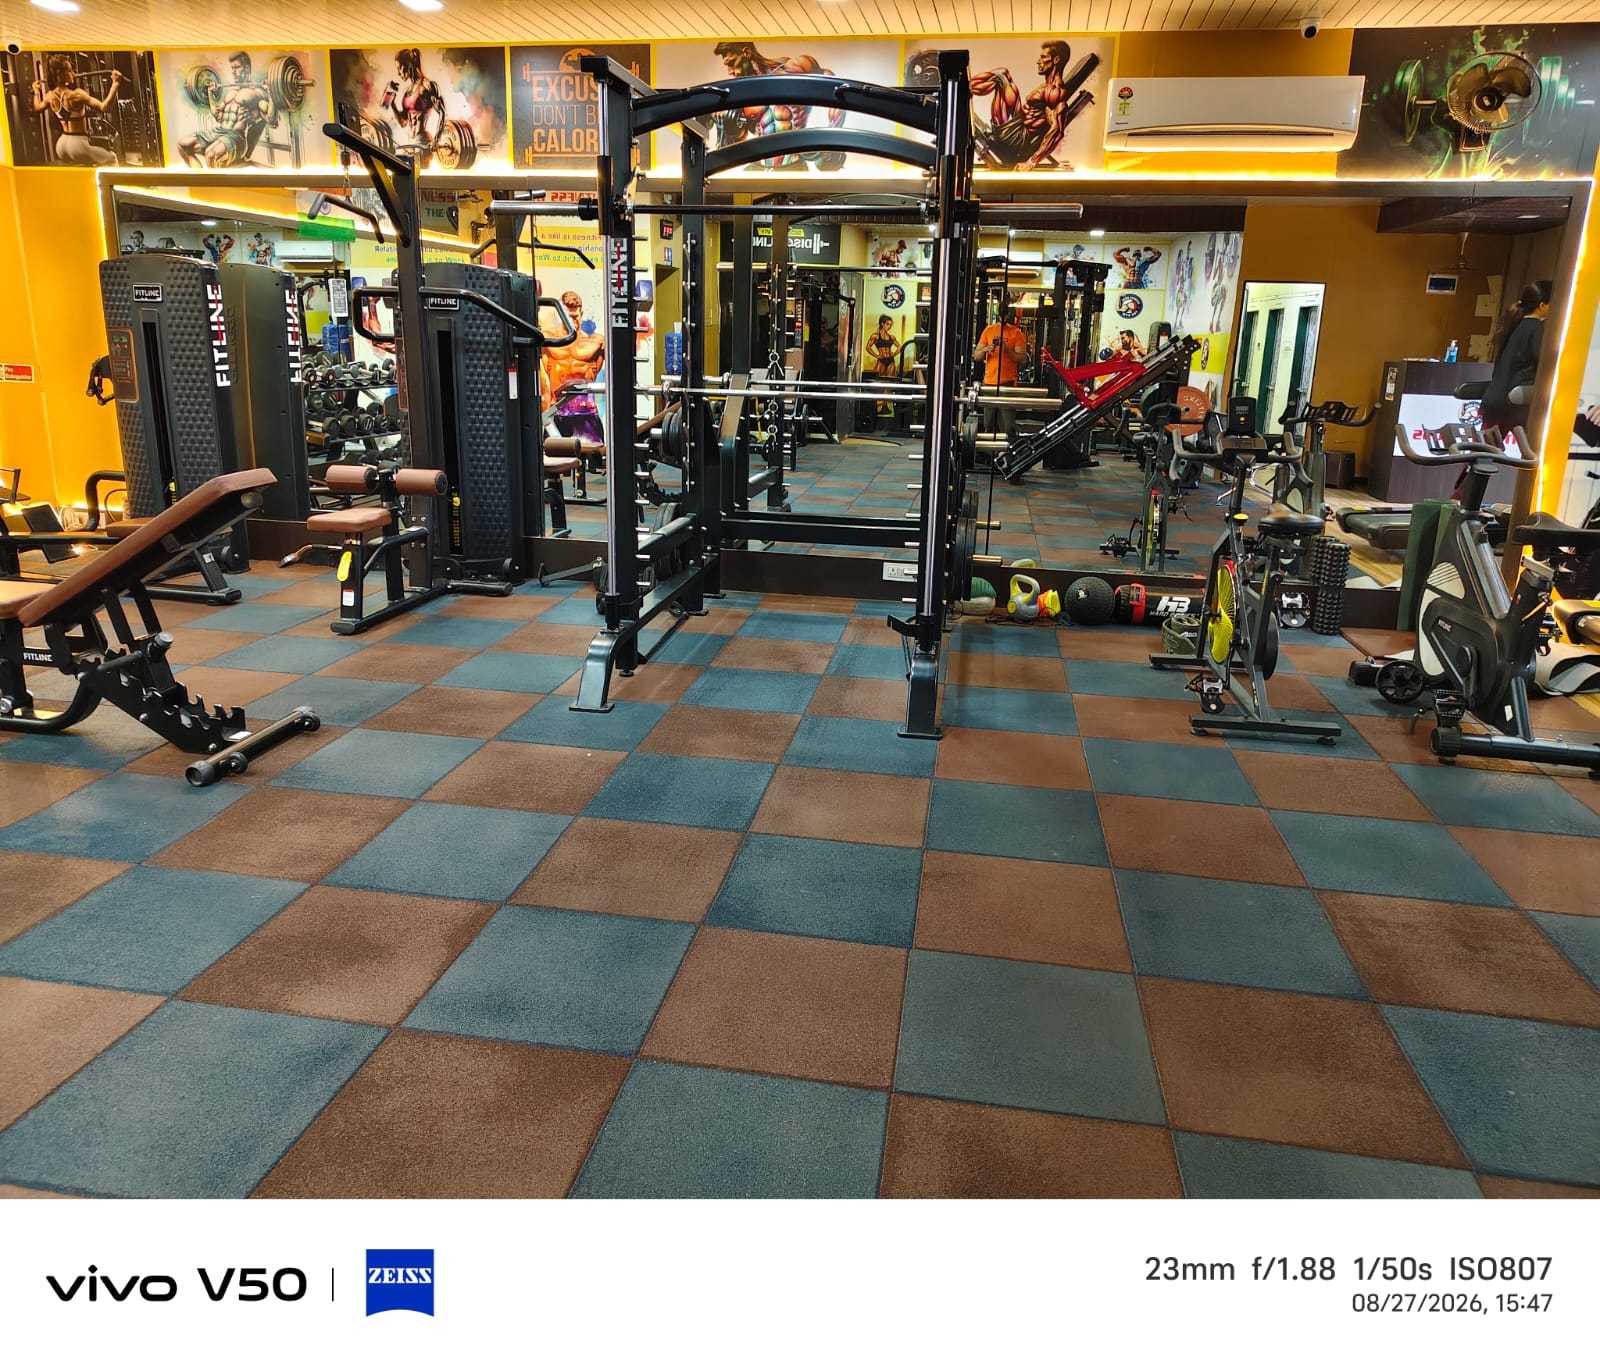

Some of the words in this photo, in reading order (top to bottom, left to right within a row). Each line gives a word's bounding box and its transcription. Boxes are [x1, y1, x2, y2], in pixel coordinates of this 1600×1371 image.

[532, 75, 599, 101] EXCUS
[532, 105, 577, 125] DON'T
[533, 128, 599, 152] CALOR
[135, 289, 160, 298] FITLINE
[611, 238, 628, 328] FITLINE
[430, 297, 457, 305] FITLINE
[207, 284, 231, 387] FITLINE
[23, 652, 54, 662] FITLINE
